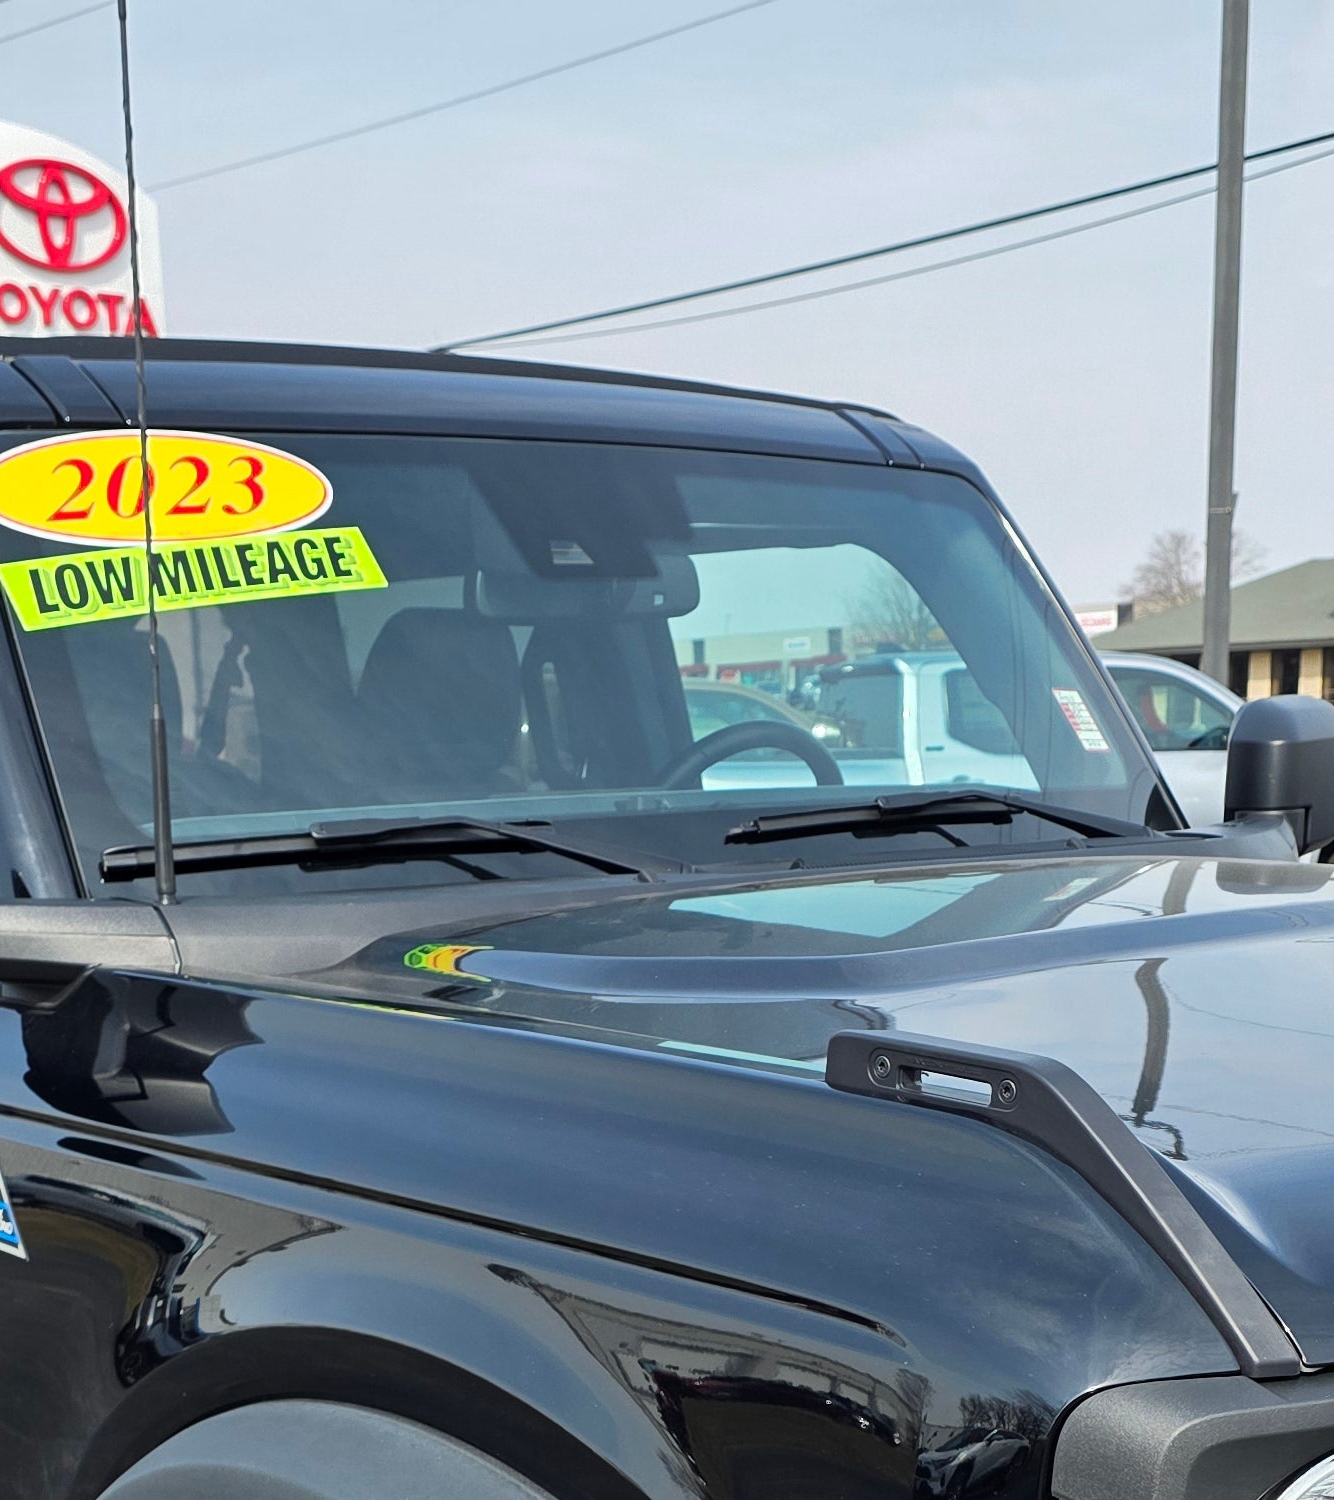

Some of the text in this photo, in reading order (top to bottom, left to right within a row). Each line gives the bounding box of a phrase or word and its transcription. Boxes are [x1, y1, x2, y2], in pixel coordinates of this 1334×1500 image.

[47, 455, 265, 522] 2023
[29, 536, 354, 614] LOW MILEAGE
